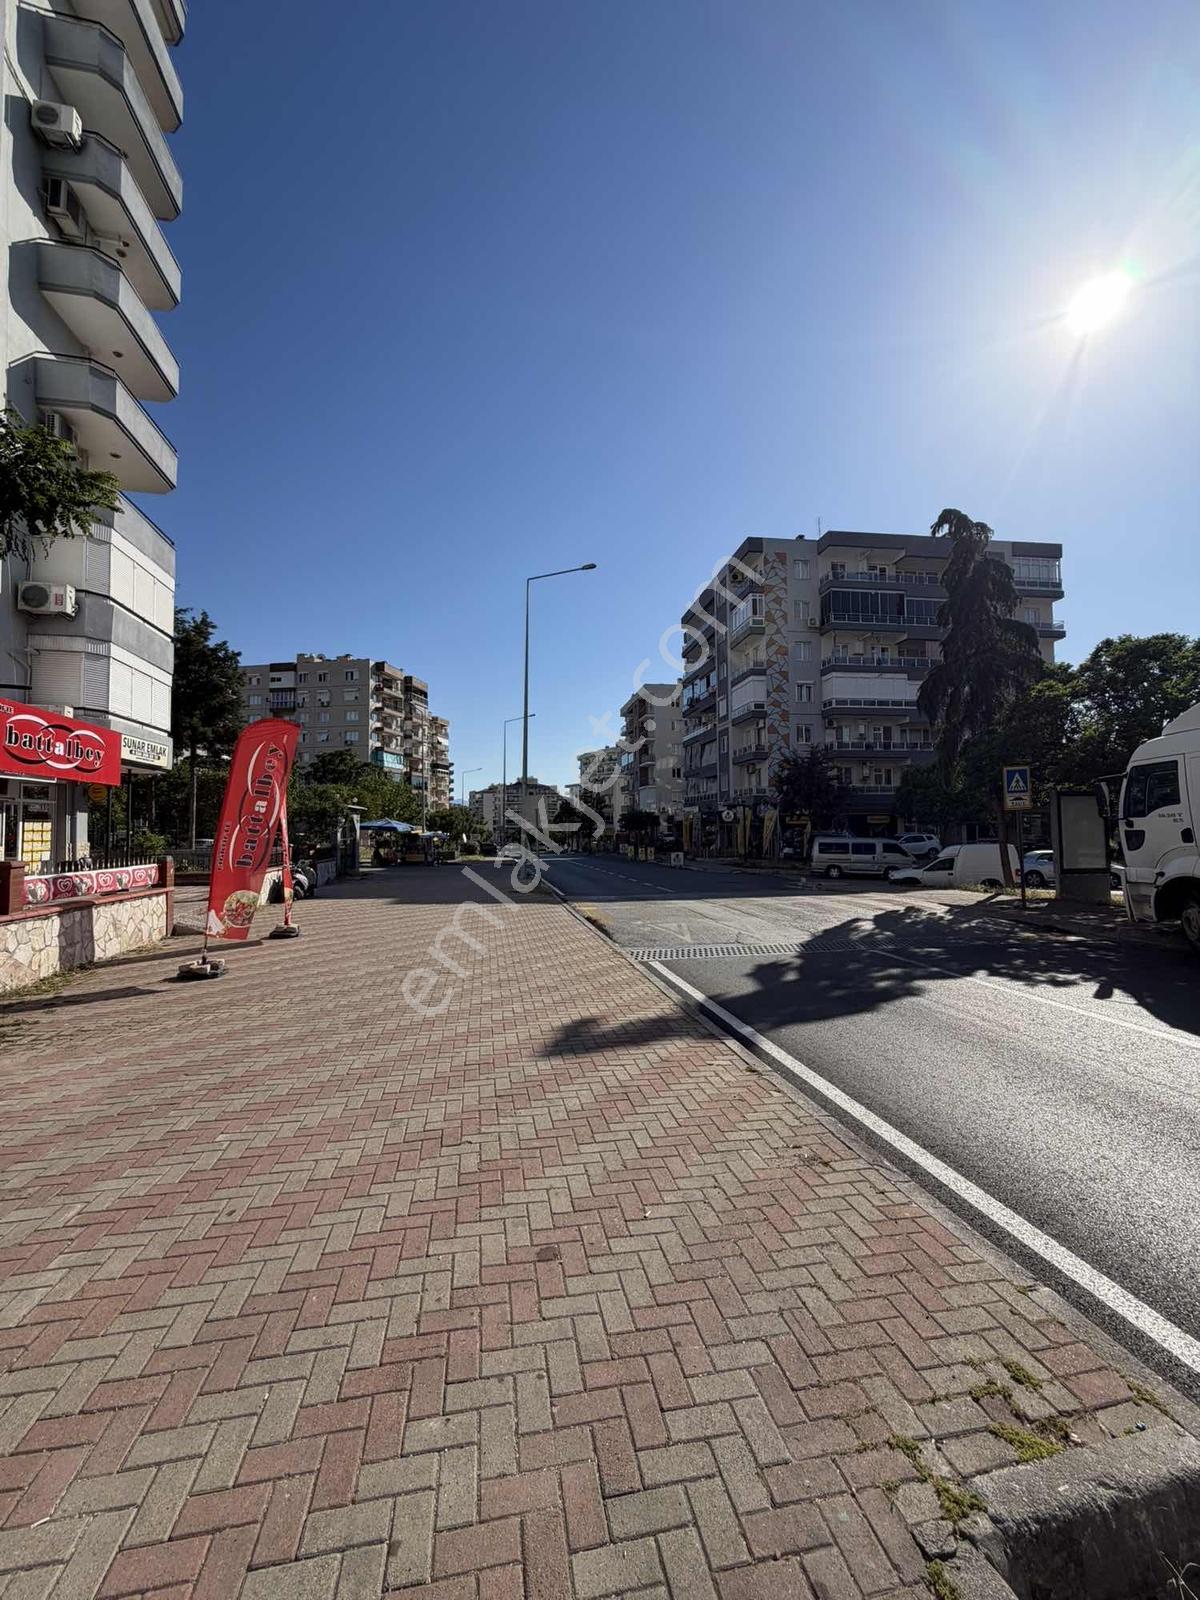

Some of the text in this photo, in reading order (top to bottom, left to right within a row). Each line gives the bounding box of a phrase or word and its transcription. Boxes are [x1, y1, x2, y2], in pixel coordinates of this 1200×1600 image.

[6, 724, 105, 768] battalbey
[123, 737, 145, 752] SUNAR
[146, 743, 168, 757] EMLAK
[235, 745, 284, 869] battalbey
